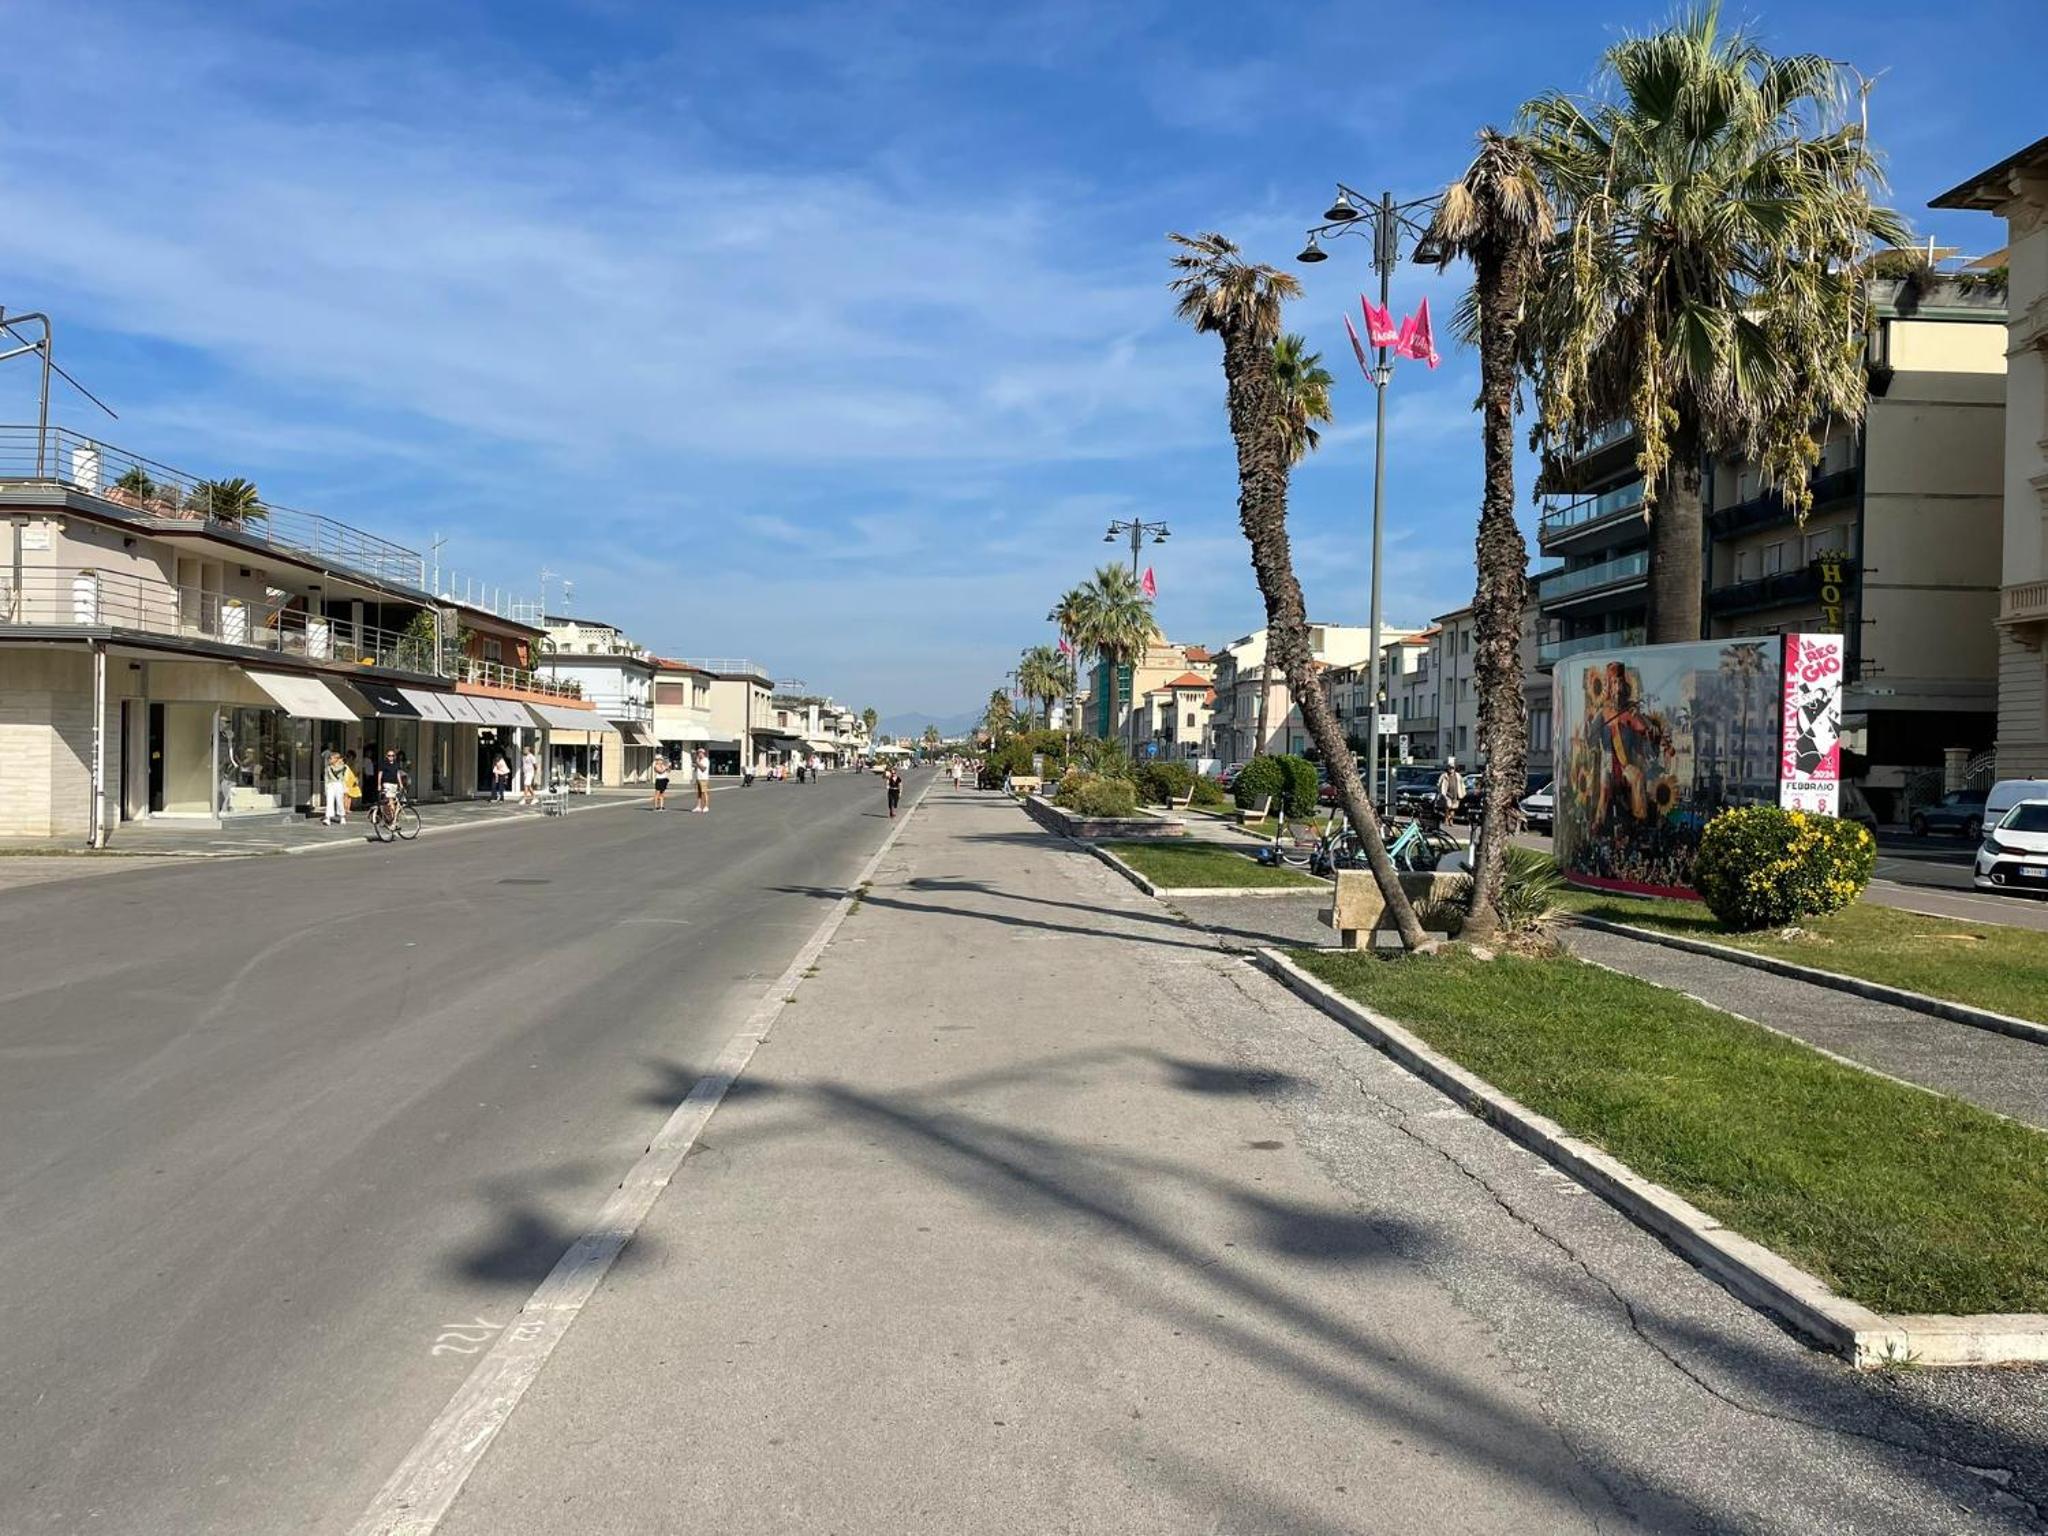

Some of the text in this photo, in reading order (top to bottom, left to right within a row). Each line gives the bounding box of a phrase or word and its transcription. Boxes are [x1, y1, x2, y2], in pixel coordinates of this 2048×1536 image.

[1805, 643, 1838, 663] REG
[1801, 656, 1840, 683] GIO
[1783, 671, 1799, 778] CARNEVALE
[1786, 782, 1834, 791] FEBBRAIO
